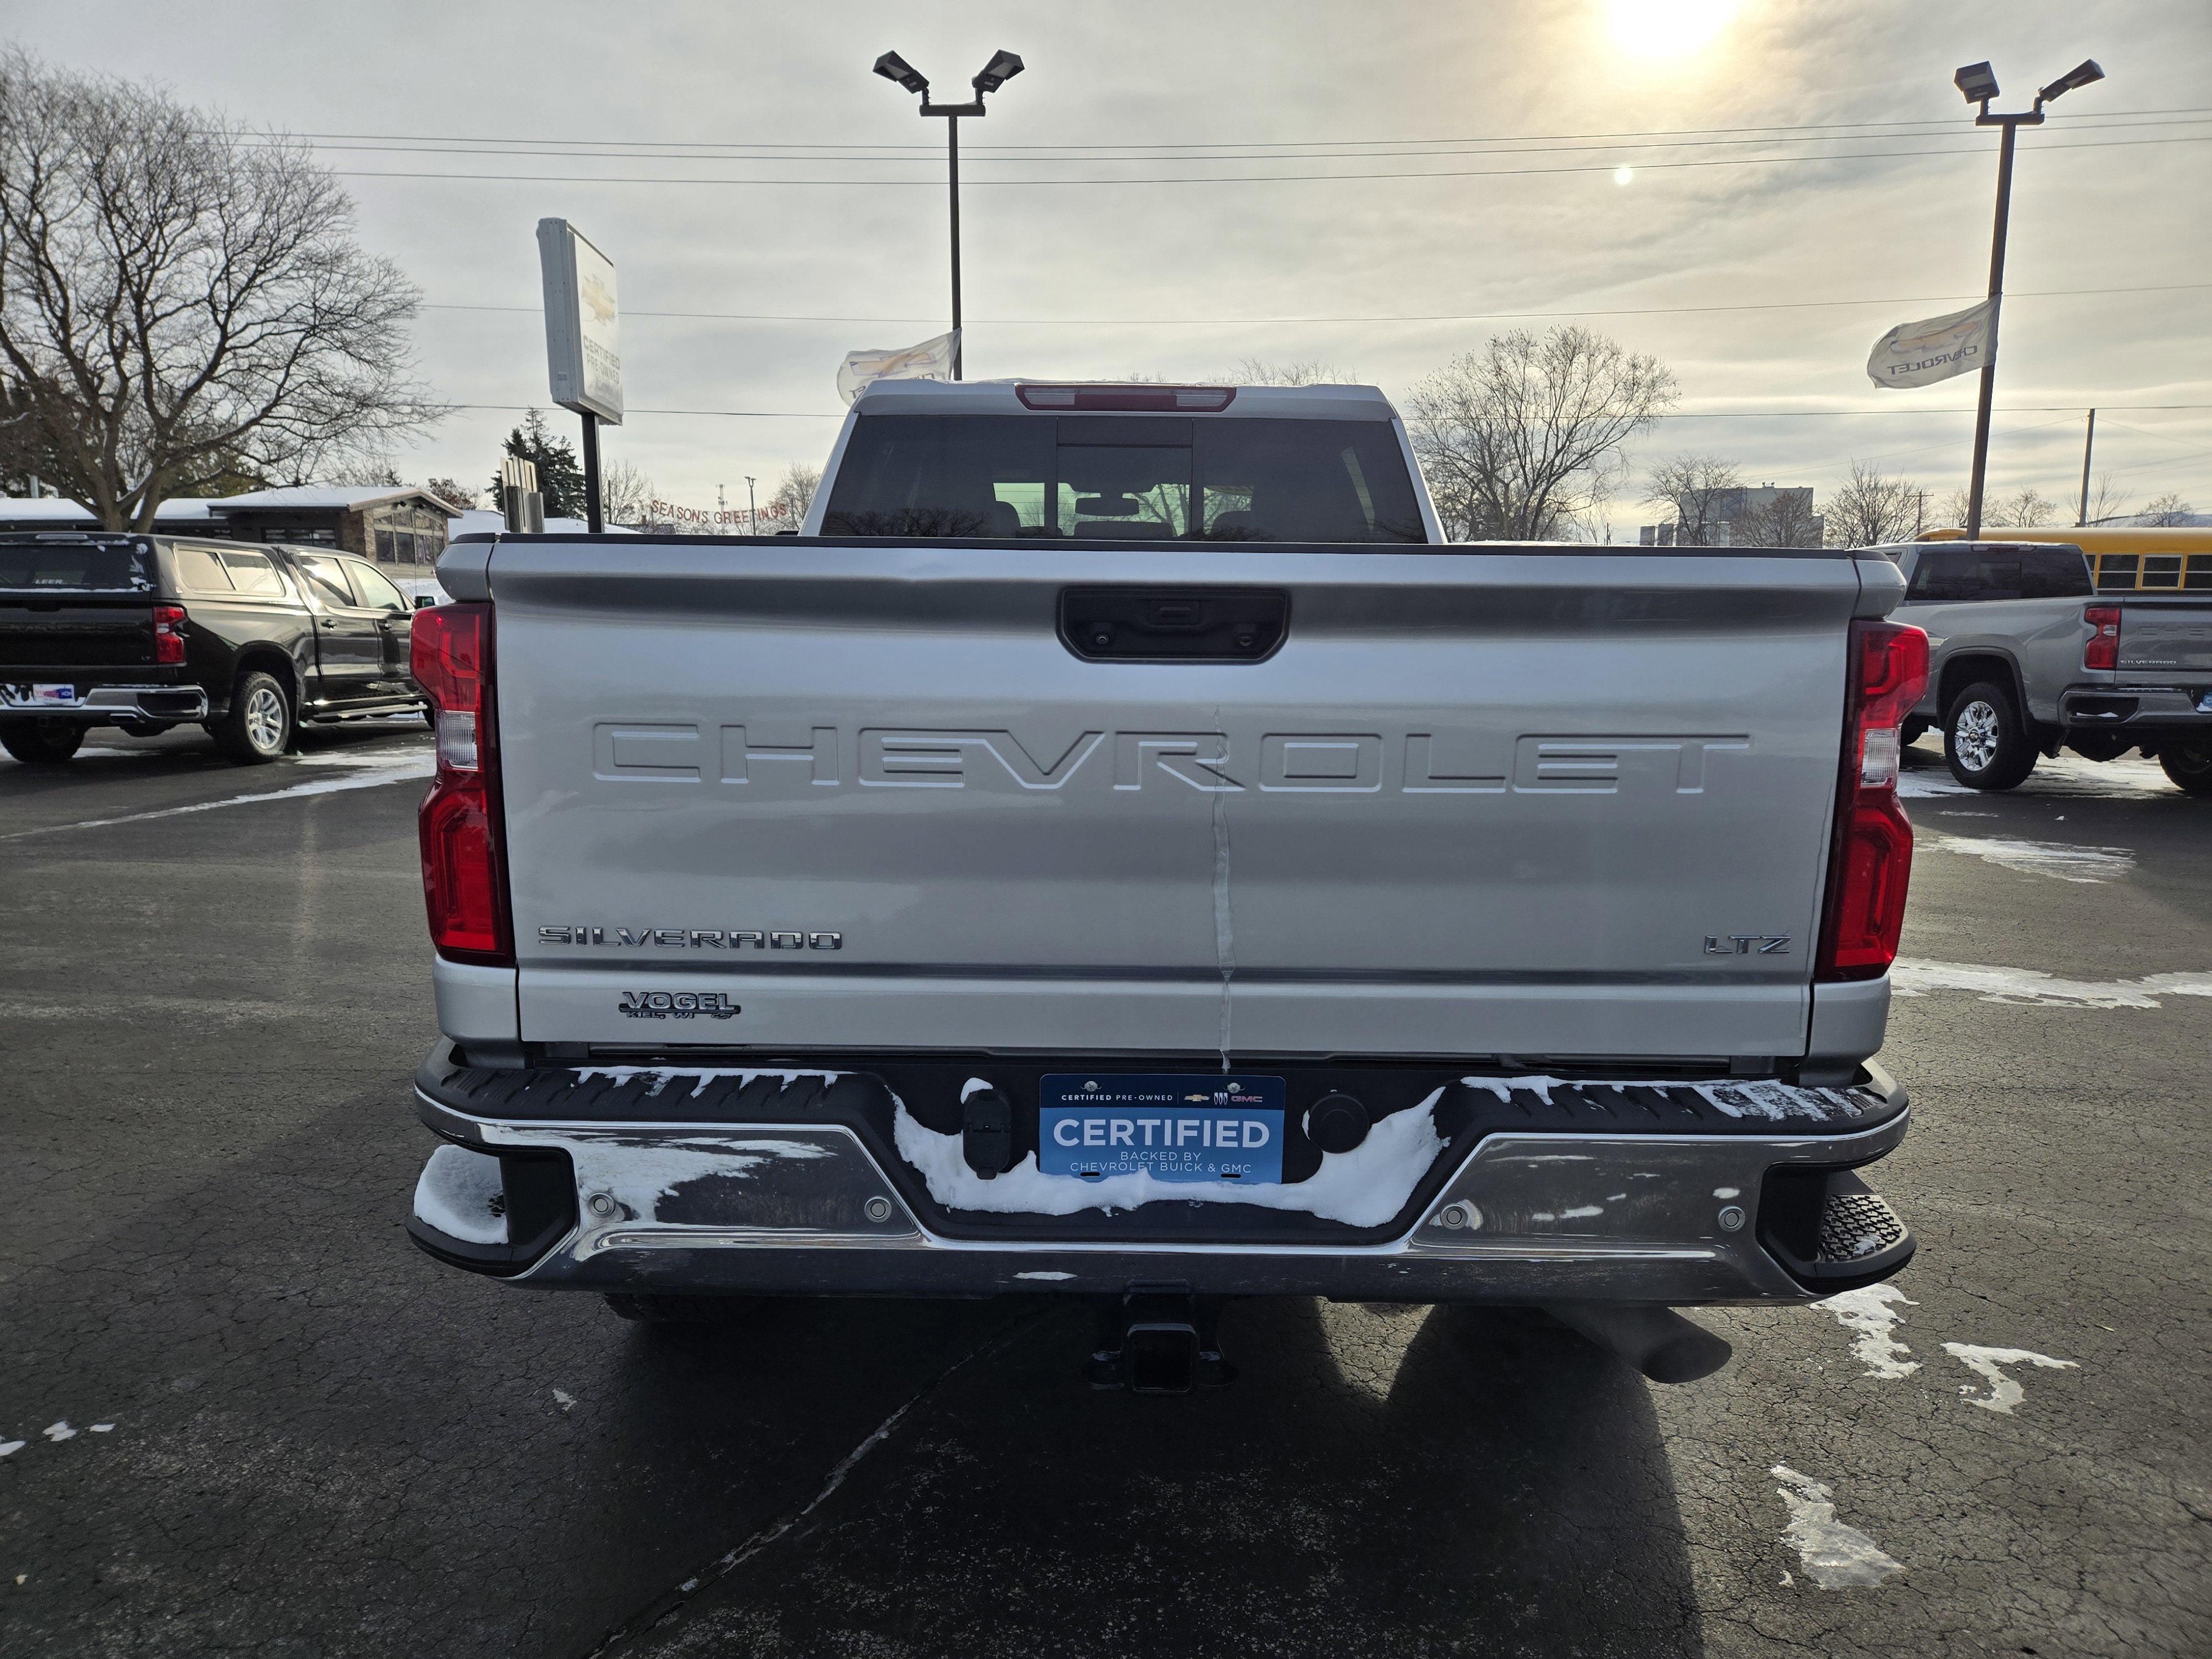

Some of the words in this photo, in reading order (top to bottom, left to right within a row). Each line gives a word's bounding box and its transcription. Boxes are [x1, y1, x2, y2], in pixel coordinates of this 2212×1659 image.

[583, 335, 620, 371] CERTIFIED
[586, 353, 619, 384] PRE-OWNED
[651, 499, 708, 524] SEASONS
[593, 722, 1750, 795] CHEVROLET
[539, 925, 842, 950] SILVERADO
[1704, 935, 1791, 954] LTZ
[622, 992, 735, 1010] VOGEL
[1053, 1119, 1270, 1148] CERTIFIED
[1070, 1162, 1154, 1172] CHEVROLET
[1160, 1162, 1203, 1172] BUICK
[1207, 1163, 1215, 1172] &
[1221, 1164, 1251, 1173] GMC
[1120, 1151, 1177, 1161] BACKED
[1184, 1152, 1201, 1161] BY
